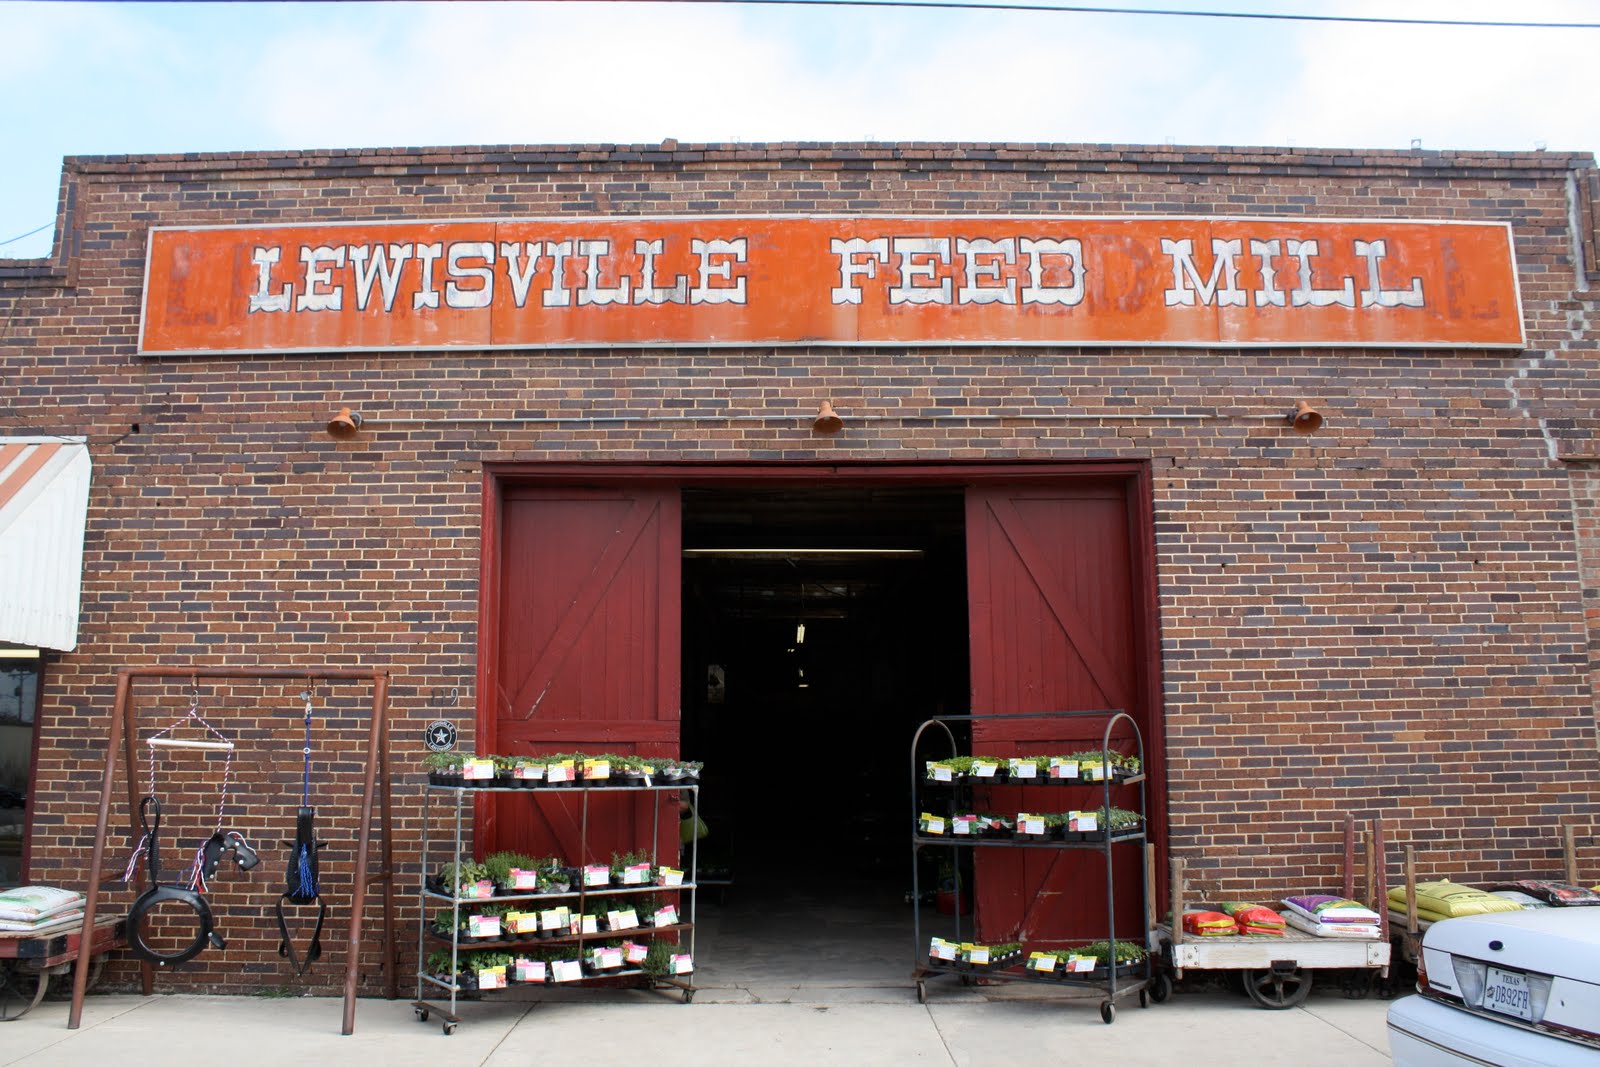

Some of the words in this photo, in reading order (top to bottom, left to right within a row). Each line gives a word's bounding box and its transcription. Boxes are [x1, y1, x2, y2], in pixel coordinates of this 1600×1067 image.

[248, 237, 748, 313] LEWISVILLE
[830, 236, 1088, 306] FEED
[1160, 238, 1425, 308] MILL
[432, 687, 458, 705] 119
[1502, 975, 1520, 985] TEXAS
[1495, 985, 1528, 1009] DB92FH
